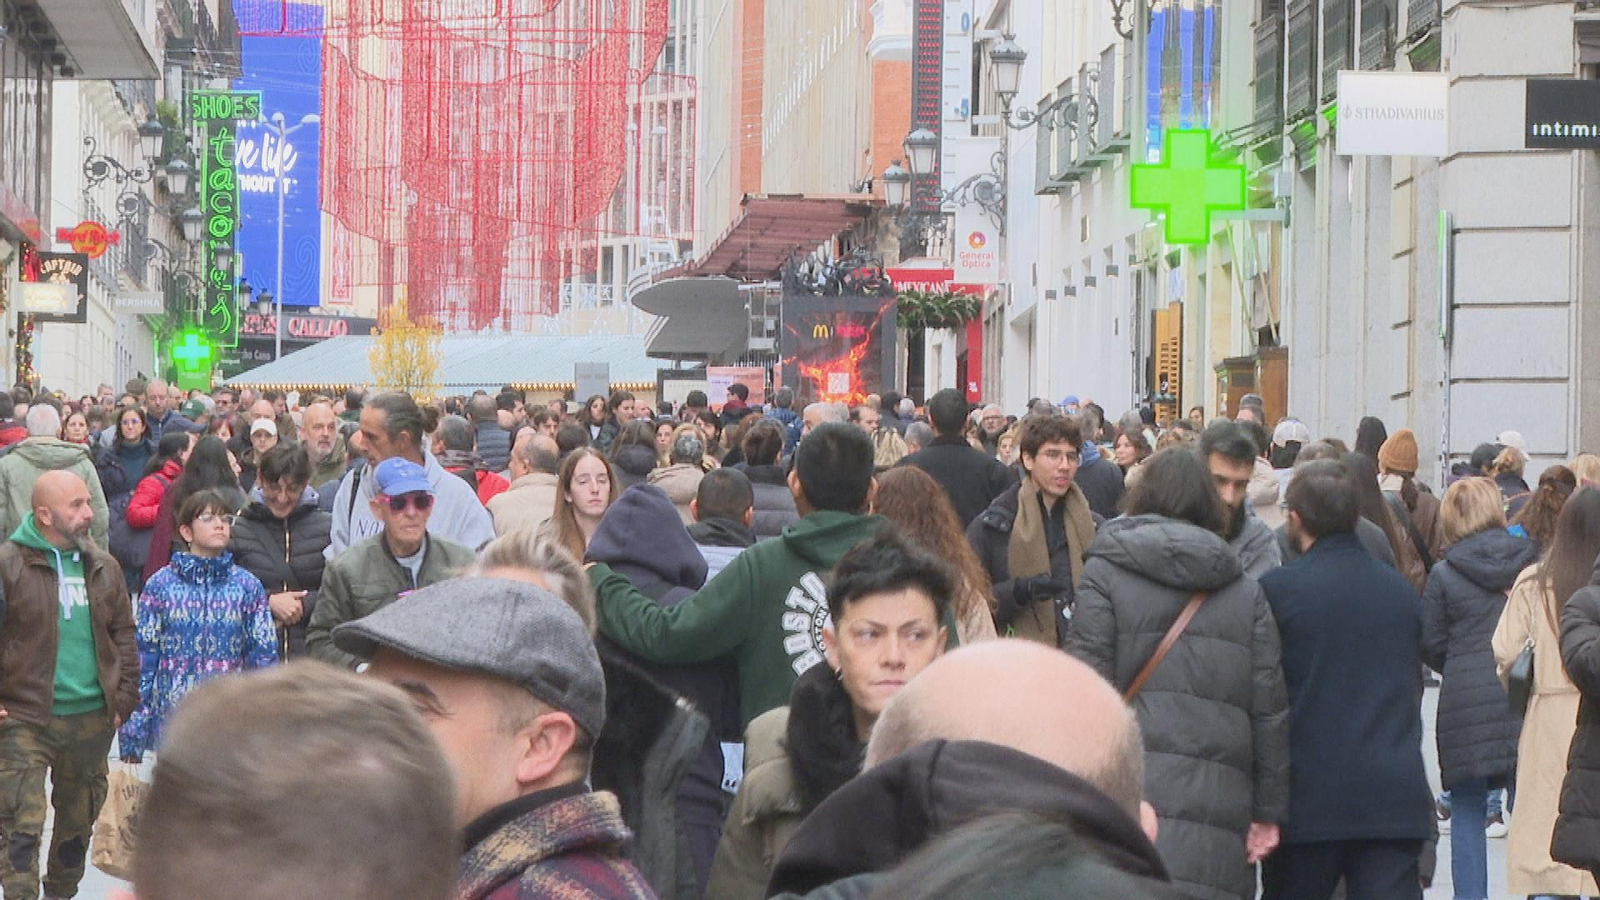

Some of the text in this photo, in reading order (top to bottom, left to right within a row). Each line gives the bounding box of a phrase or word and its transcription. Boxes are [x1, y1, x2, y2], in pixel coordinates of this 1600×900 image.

[191, 94, 259, 119] SHOES
[1354, 106, 1445, 121] STRADIVARIUS
[1532, 122, 1600, 138] intimi
[959, 251, 994, 260] General
[961, 259, 991, 269] Optica
[288, 316, 348, 338] CALLAO
[782, 571, 828, 677] BOSTO
